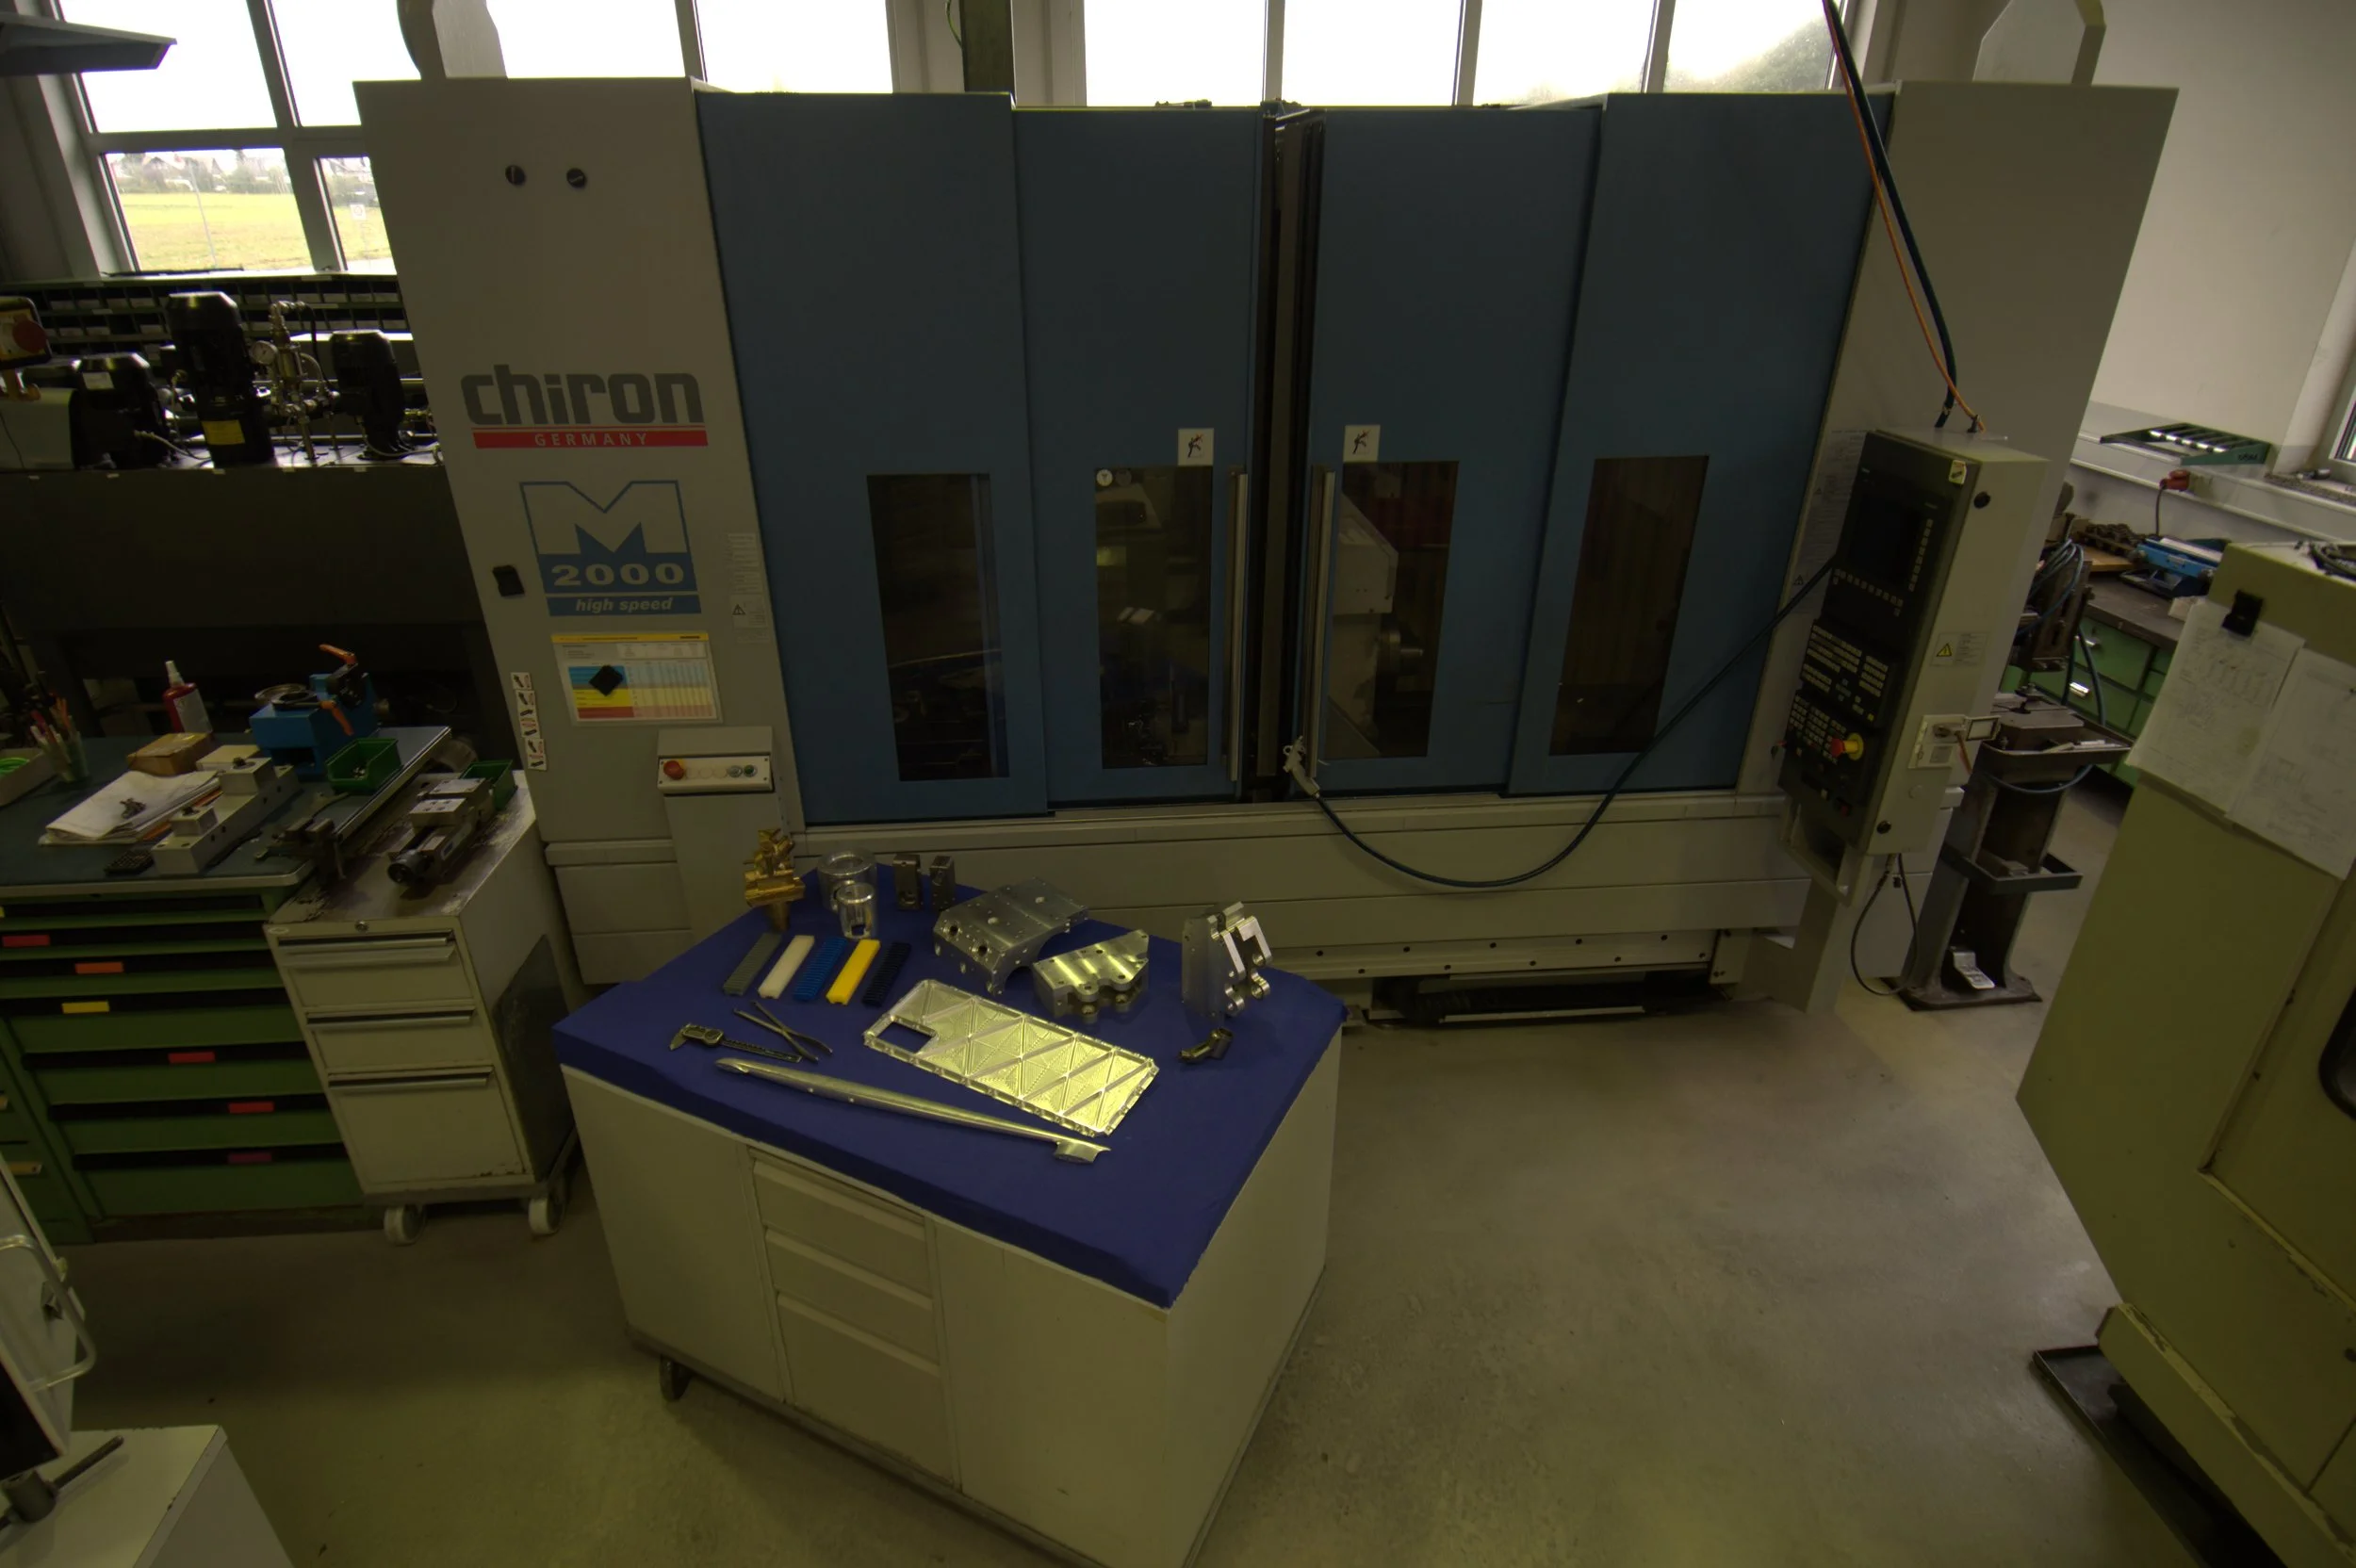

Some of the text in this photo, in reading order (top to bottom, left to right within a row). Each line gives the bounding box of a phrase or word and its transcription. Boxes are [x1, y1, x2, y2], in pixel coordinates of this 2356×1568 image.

[461, 365, 705, 425] chiron
[534, 433, 648, 447] GERMANY
[519, 481, 689, 555] M
[551, 564, 684, 587] 2000
[576, 596, 674, 614] high speed
